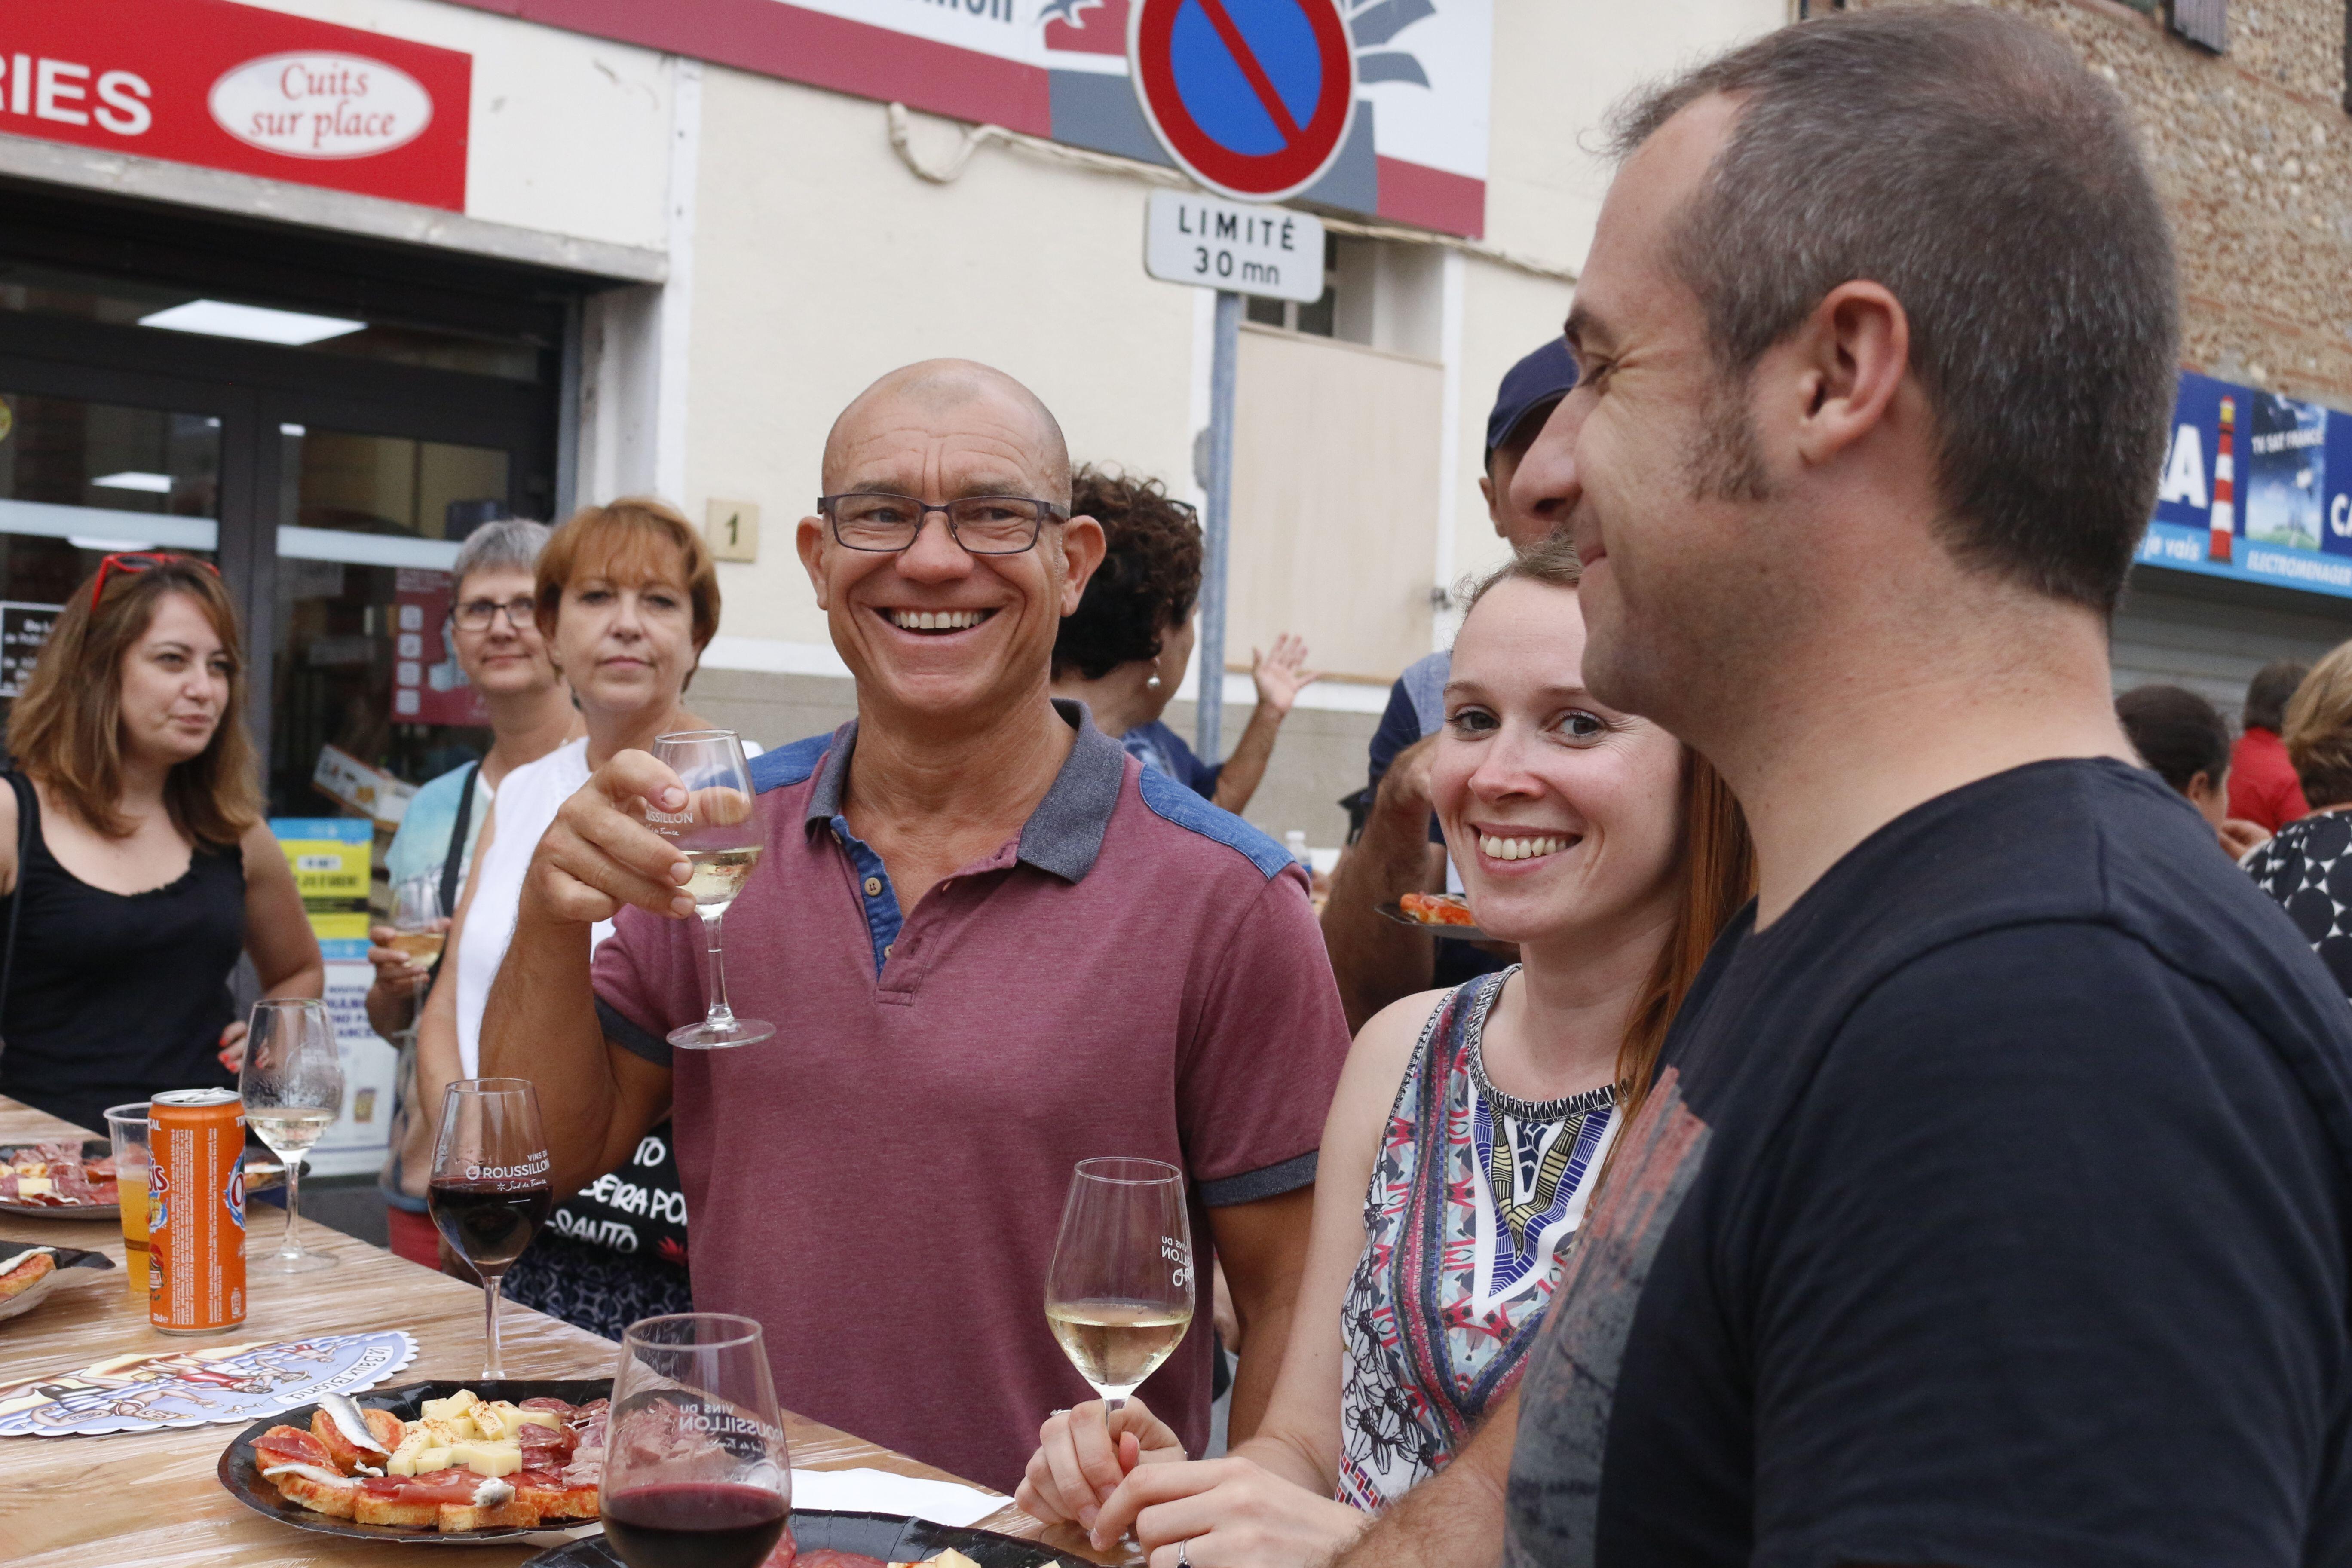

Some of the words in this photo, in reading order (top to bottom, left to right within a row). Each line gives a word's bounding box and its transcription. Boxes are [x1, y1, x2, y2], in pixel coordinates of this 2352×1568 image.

[280, 61, 368, 100] Cuits
[250, 111, 304, 136] sur
[313, 98, 395, 148] place
[1179, 205, 1295, 251] LIMITÉ
[1194, 247, 1233, 277] 30
[1242, 260, 1280, 285] mn
[725, 512, 739, 546] 1
[483, 1158, 550, 1179] ROUSSILLON
[527, 1152, 541, 1161] VINS
[505, 1181, 521, 1191] Sud
[530, 1178, 547, 1188] France
[285, 1376, 354, 1400] Blond
